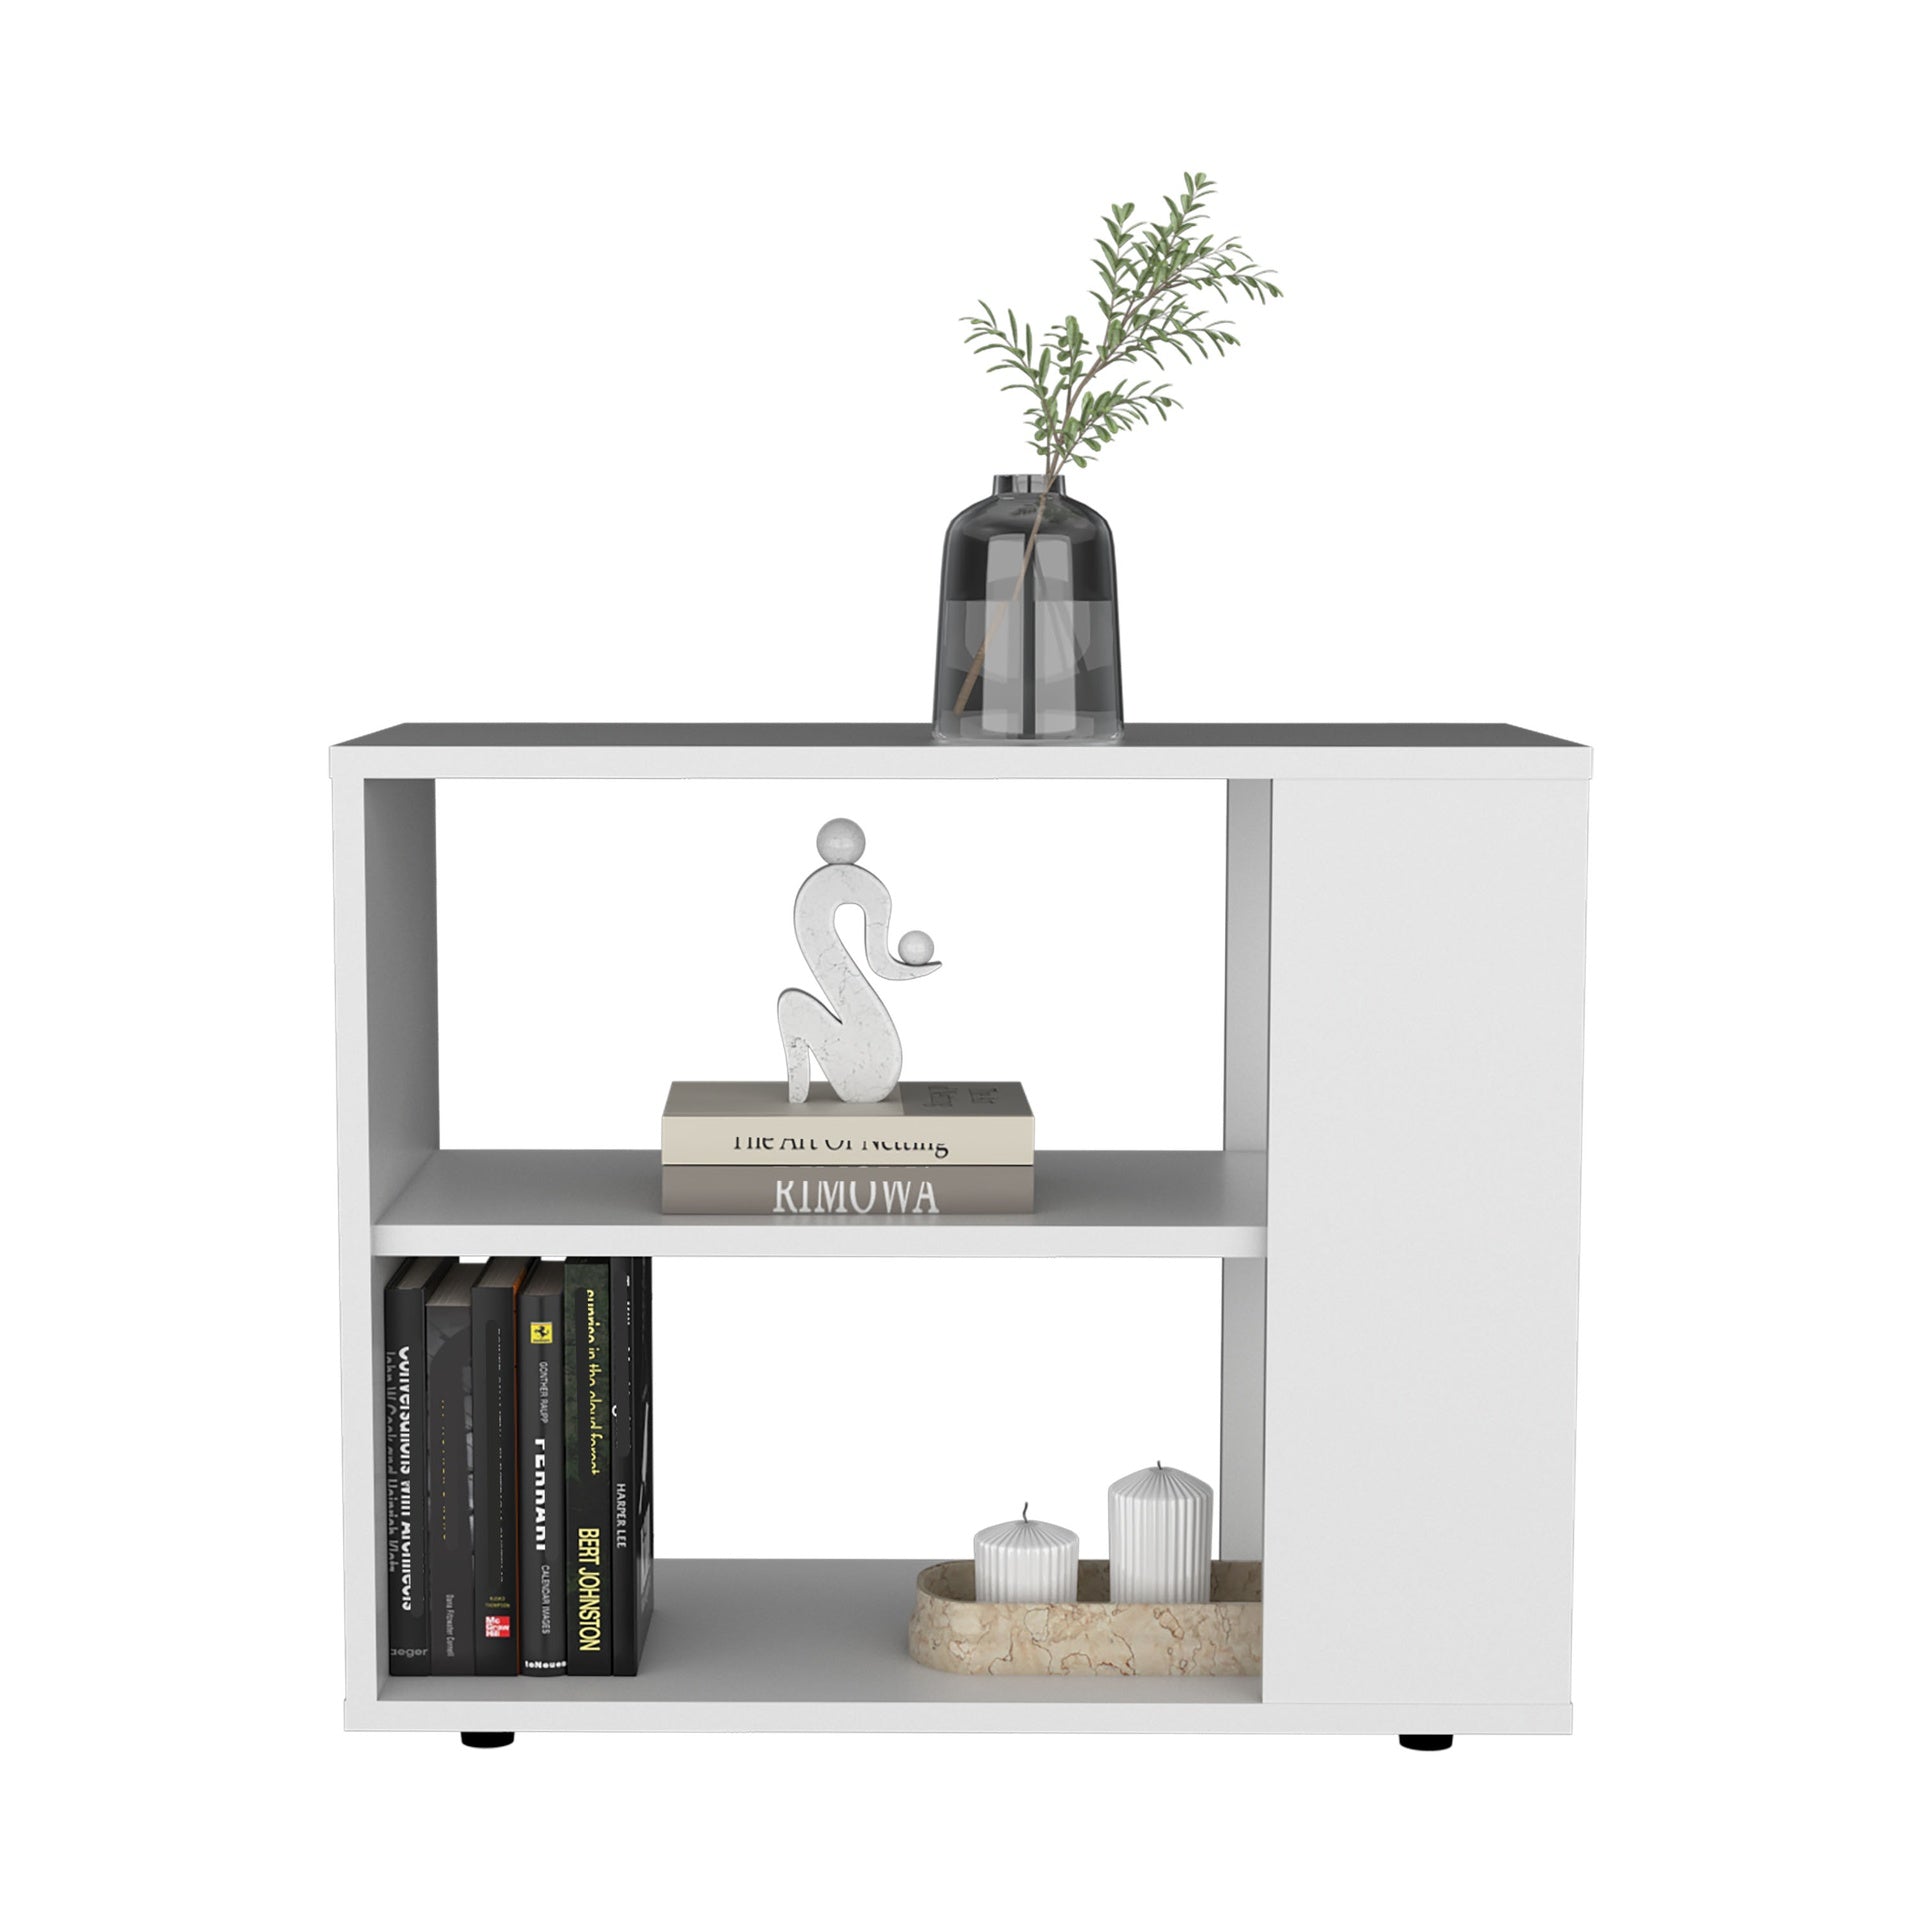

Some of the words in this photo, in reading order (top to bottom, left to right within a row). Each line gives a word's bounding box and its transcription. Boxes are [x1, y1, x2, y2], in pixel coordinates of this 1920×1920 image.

[616, 1483, 626, 1527] HARPER
[578, 1528, 600, 1565] BERT
[616, 1529, 627, 1548] LEE
[578, 1567, 601, 1651] JOHNSTON
